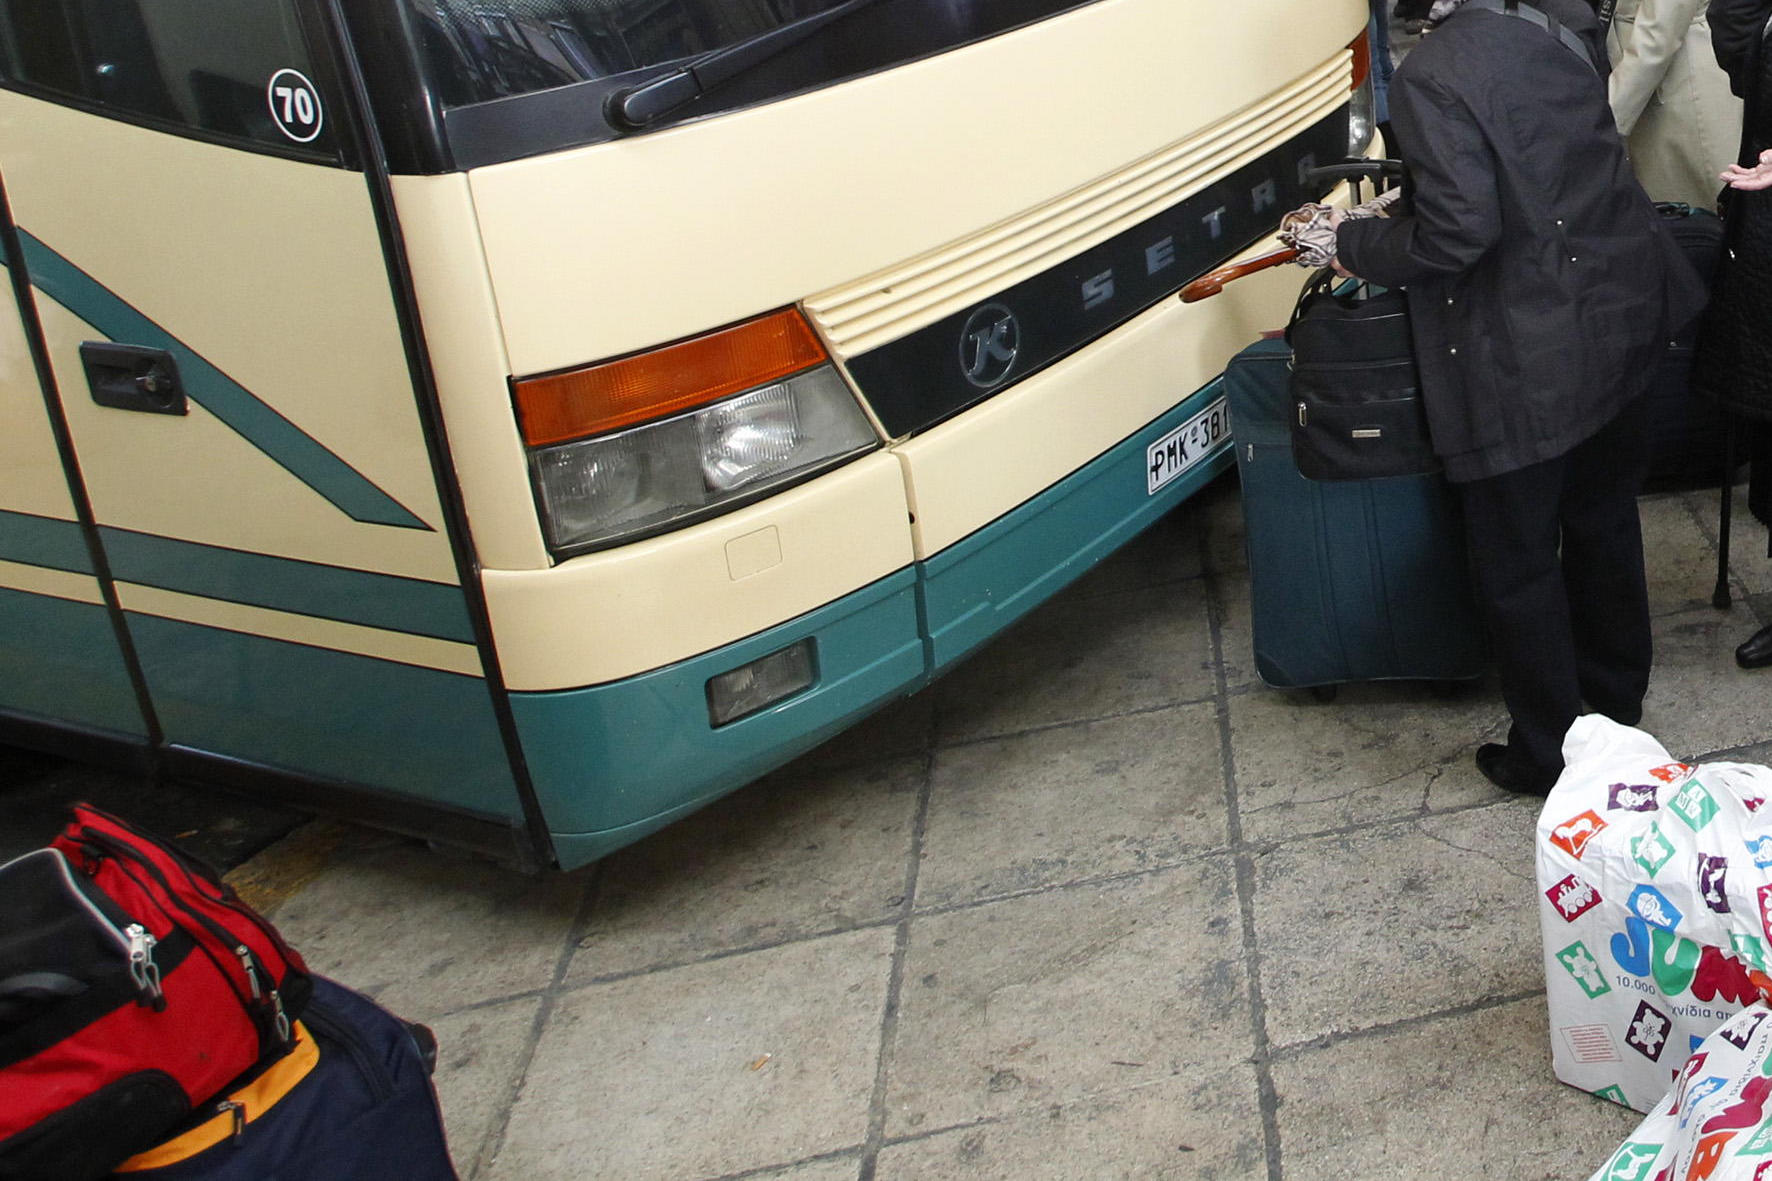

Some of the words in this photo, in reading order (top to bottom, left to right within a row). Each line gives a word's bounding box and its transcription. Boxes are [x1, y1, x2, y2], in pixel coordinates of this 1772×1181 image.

[275, 86, 314, 125] 70
[1150, 402, 1228, 482] PMK-381
[1616, 975, 1656, 995] 10.000
[1668, 1004, 1711, 1019] χνίδια
